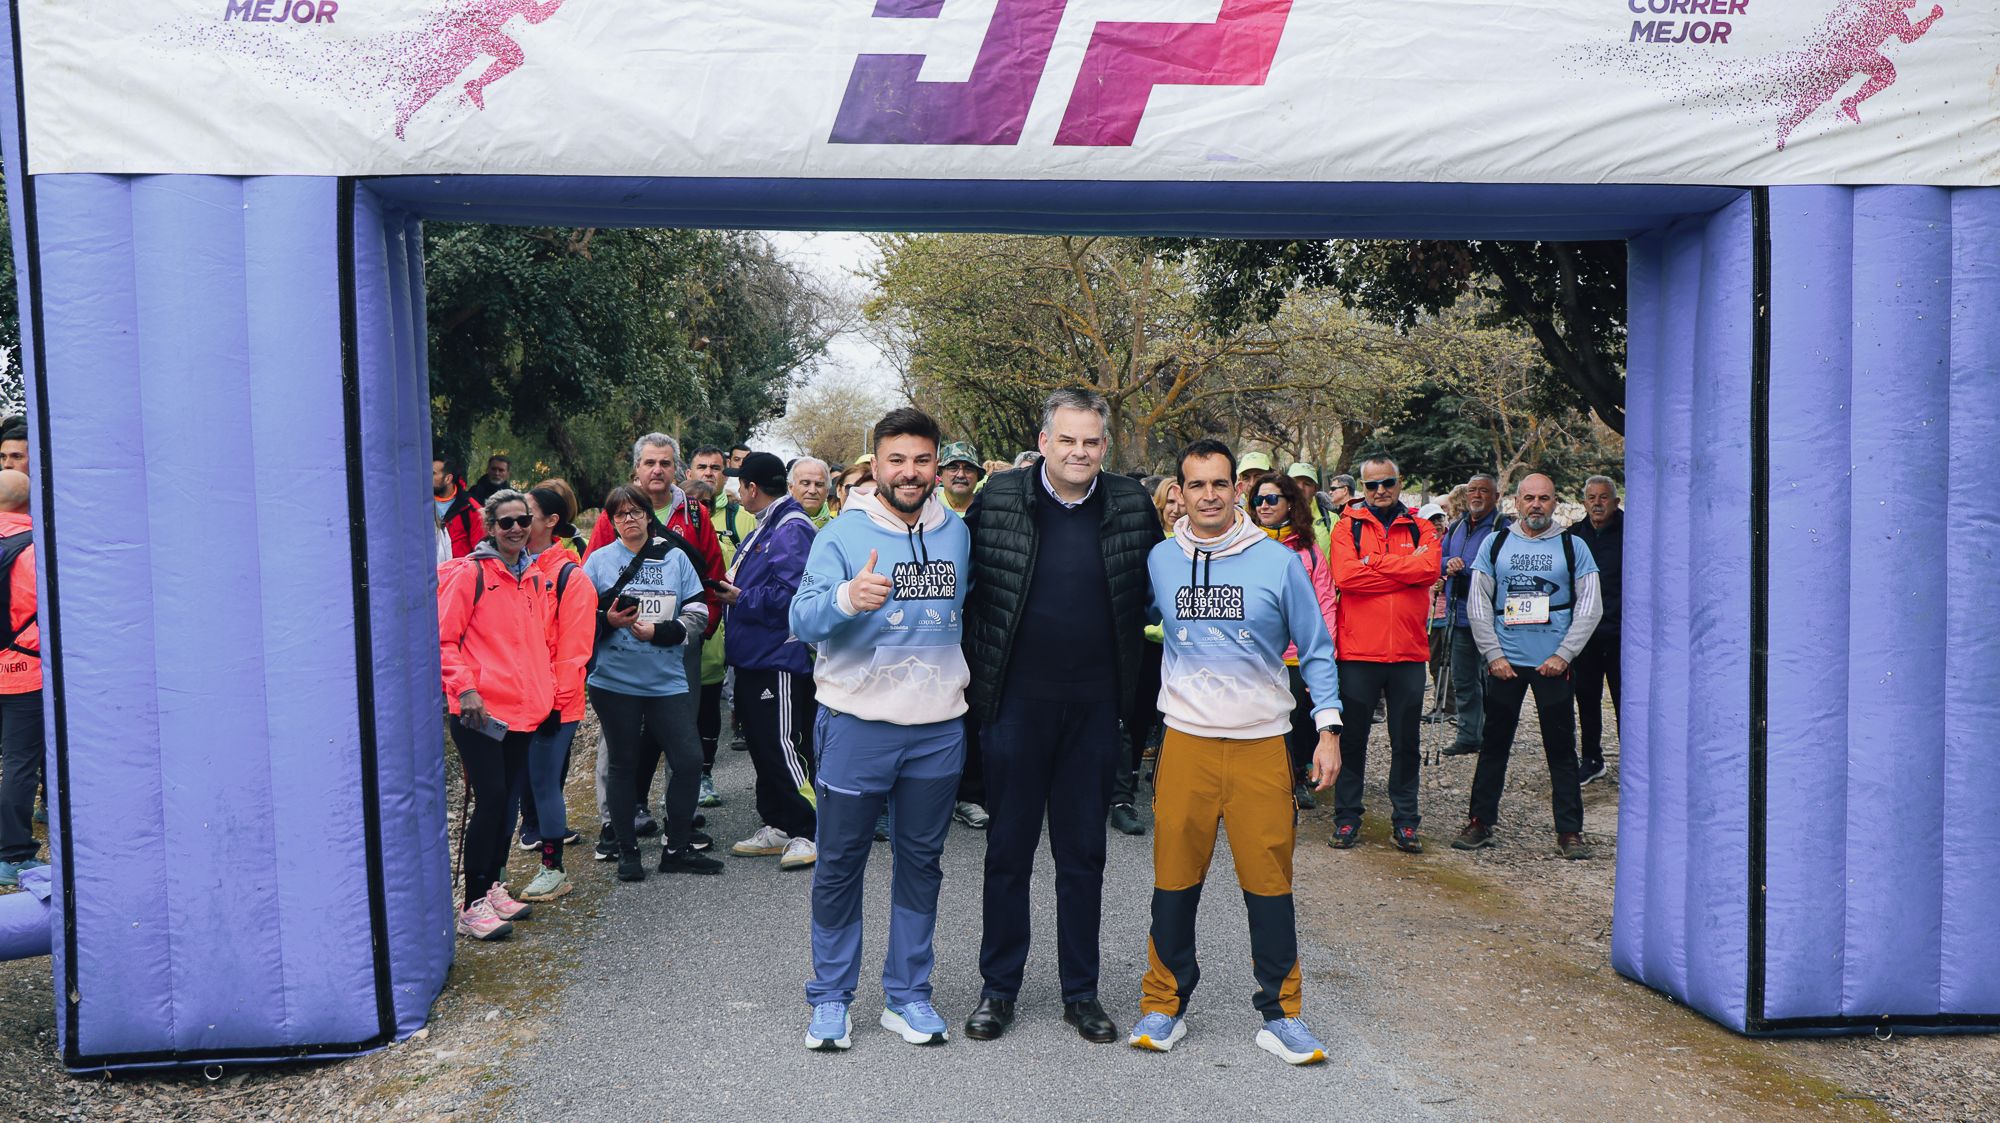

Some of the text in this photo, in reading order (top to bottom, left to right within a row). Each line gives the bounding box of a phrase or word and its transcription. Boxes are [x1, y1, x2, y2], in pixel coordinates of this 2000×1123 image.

[223, 0, 339, 23] MEJOR
[1628, 0, 1750, 15] CORRER
[1628, 20, 1732, 44] MEJOR
[895, 573, 956, 588] SUBBÉTICO
[640, 599, 661, 614] 120
[1518, 601, 1532, 613] 49
